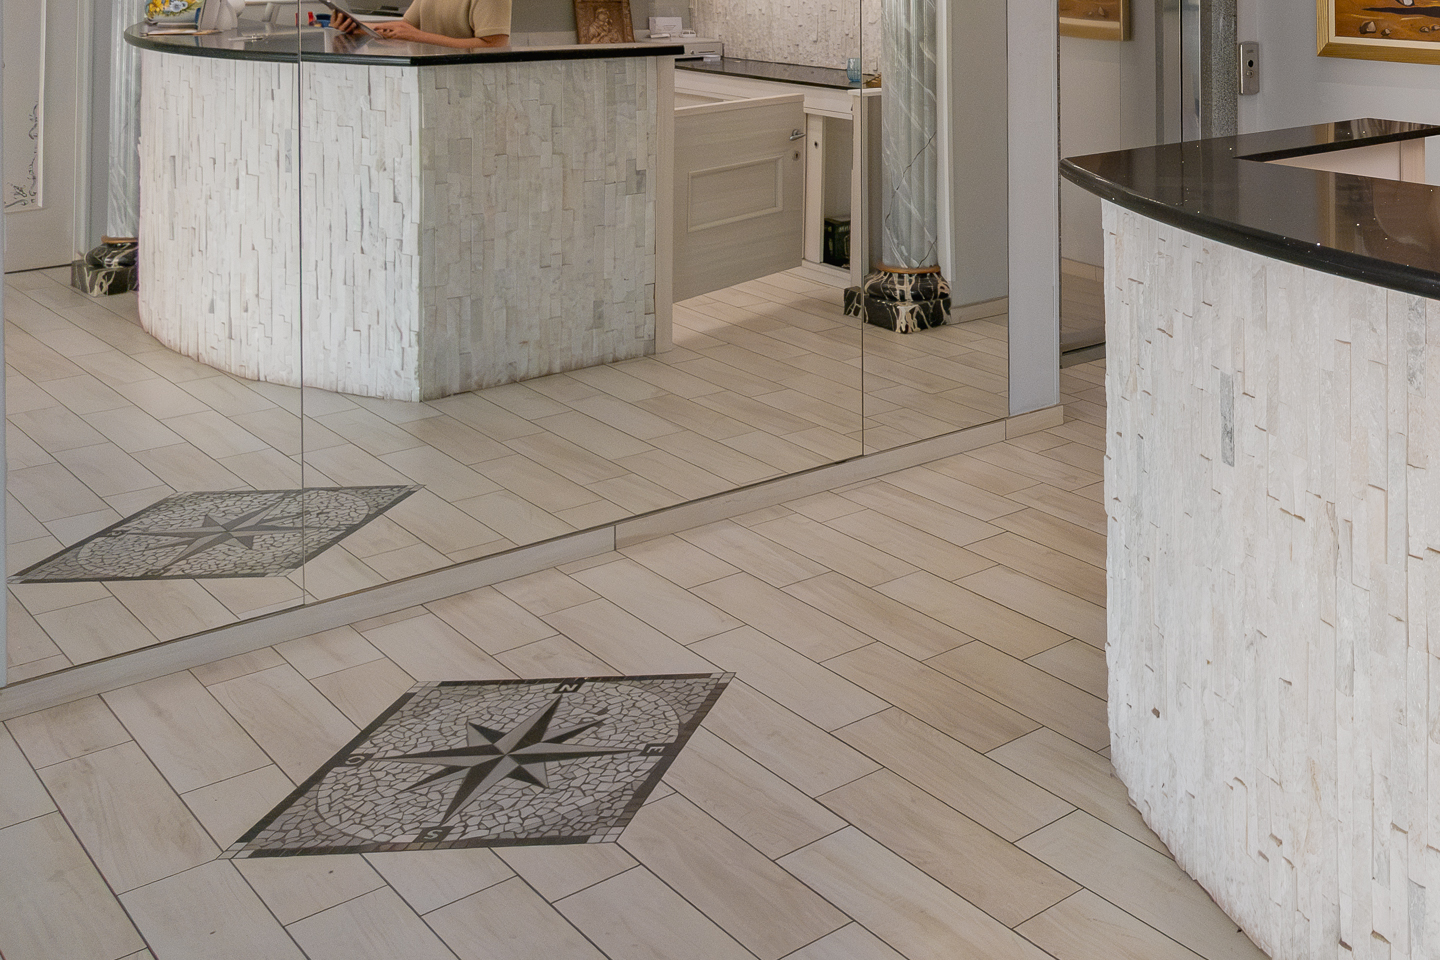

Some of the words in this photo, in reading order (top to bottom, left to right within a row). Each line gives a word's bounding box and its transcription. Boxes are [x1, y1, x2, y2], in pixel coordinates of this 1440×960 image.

[559, 683, 578, 692] N
[646, 745, 665, 754] E
[423, 828, 443, 840] S
